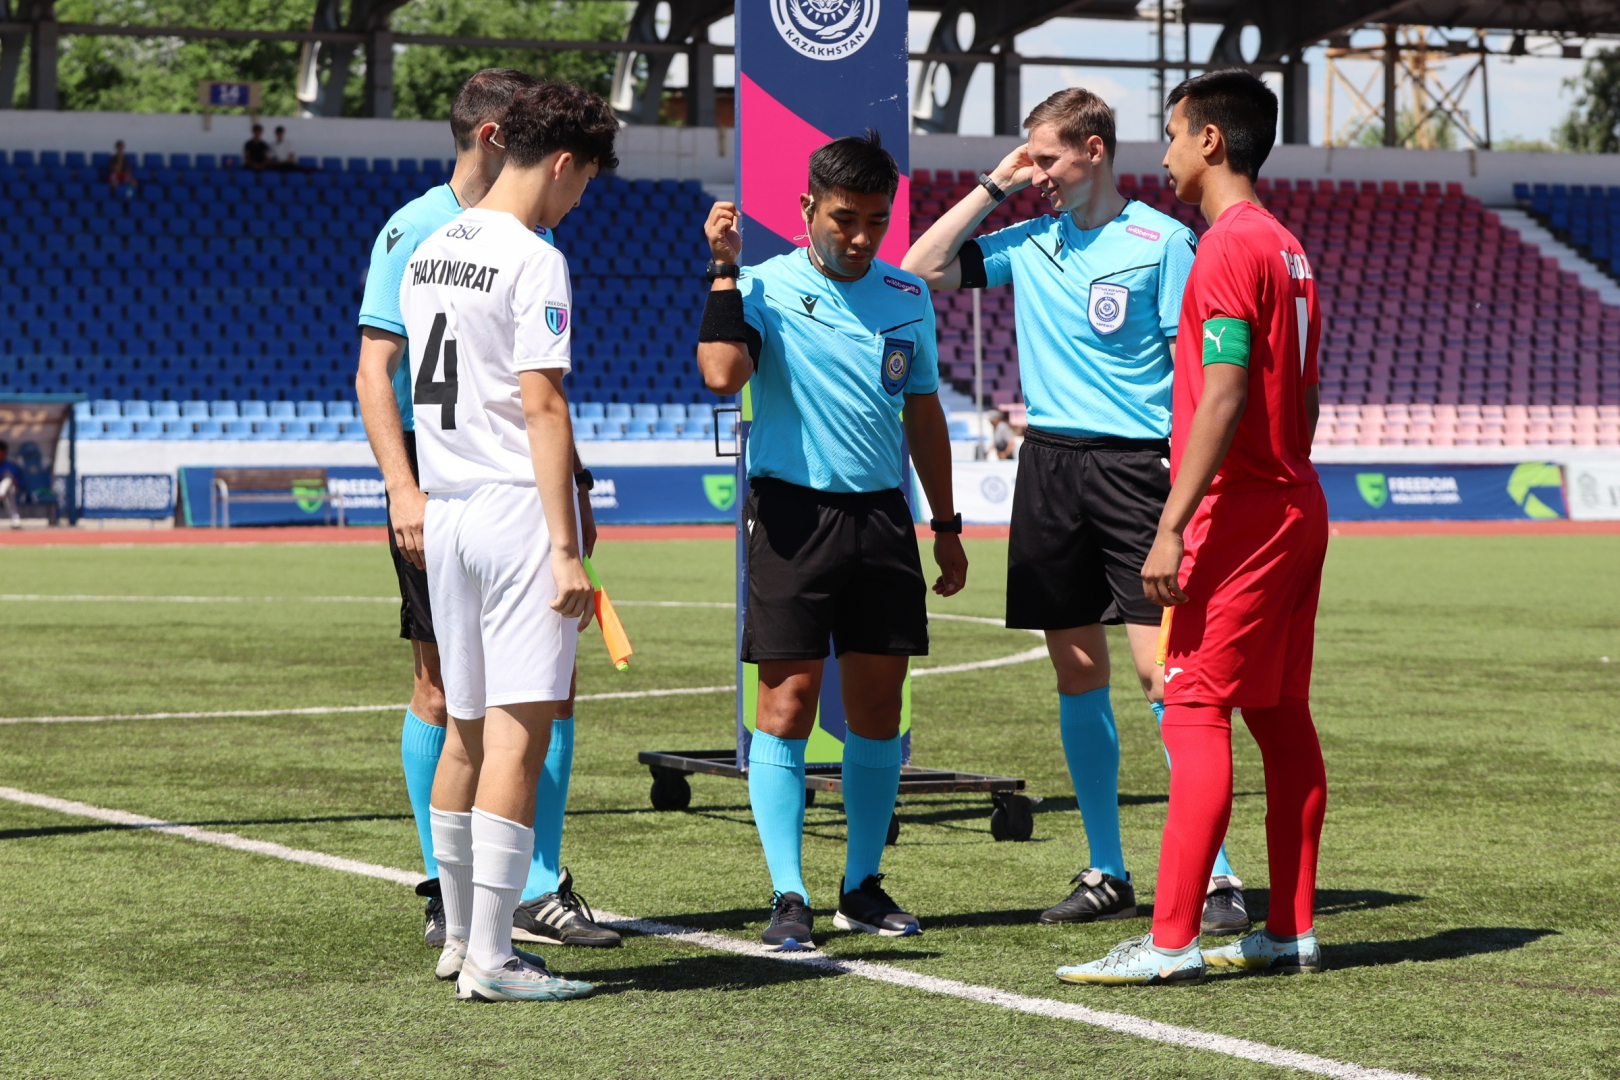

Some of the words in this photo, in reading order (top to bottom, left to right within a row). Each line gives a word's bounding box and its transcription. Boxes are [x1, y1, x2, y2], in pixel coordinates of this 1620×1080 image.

[785, 29, 865, 56] KAZAKHSTAN
[446, 223, 483, 241] asu
[545, 300, 568, 308] FREEDOM
[414, 312, 459, 430] 4
[328, 478, 386, 495] FREED
[1388, 476, 1459, 492] FREEDOM
